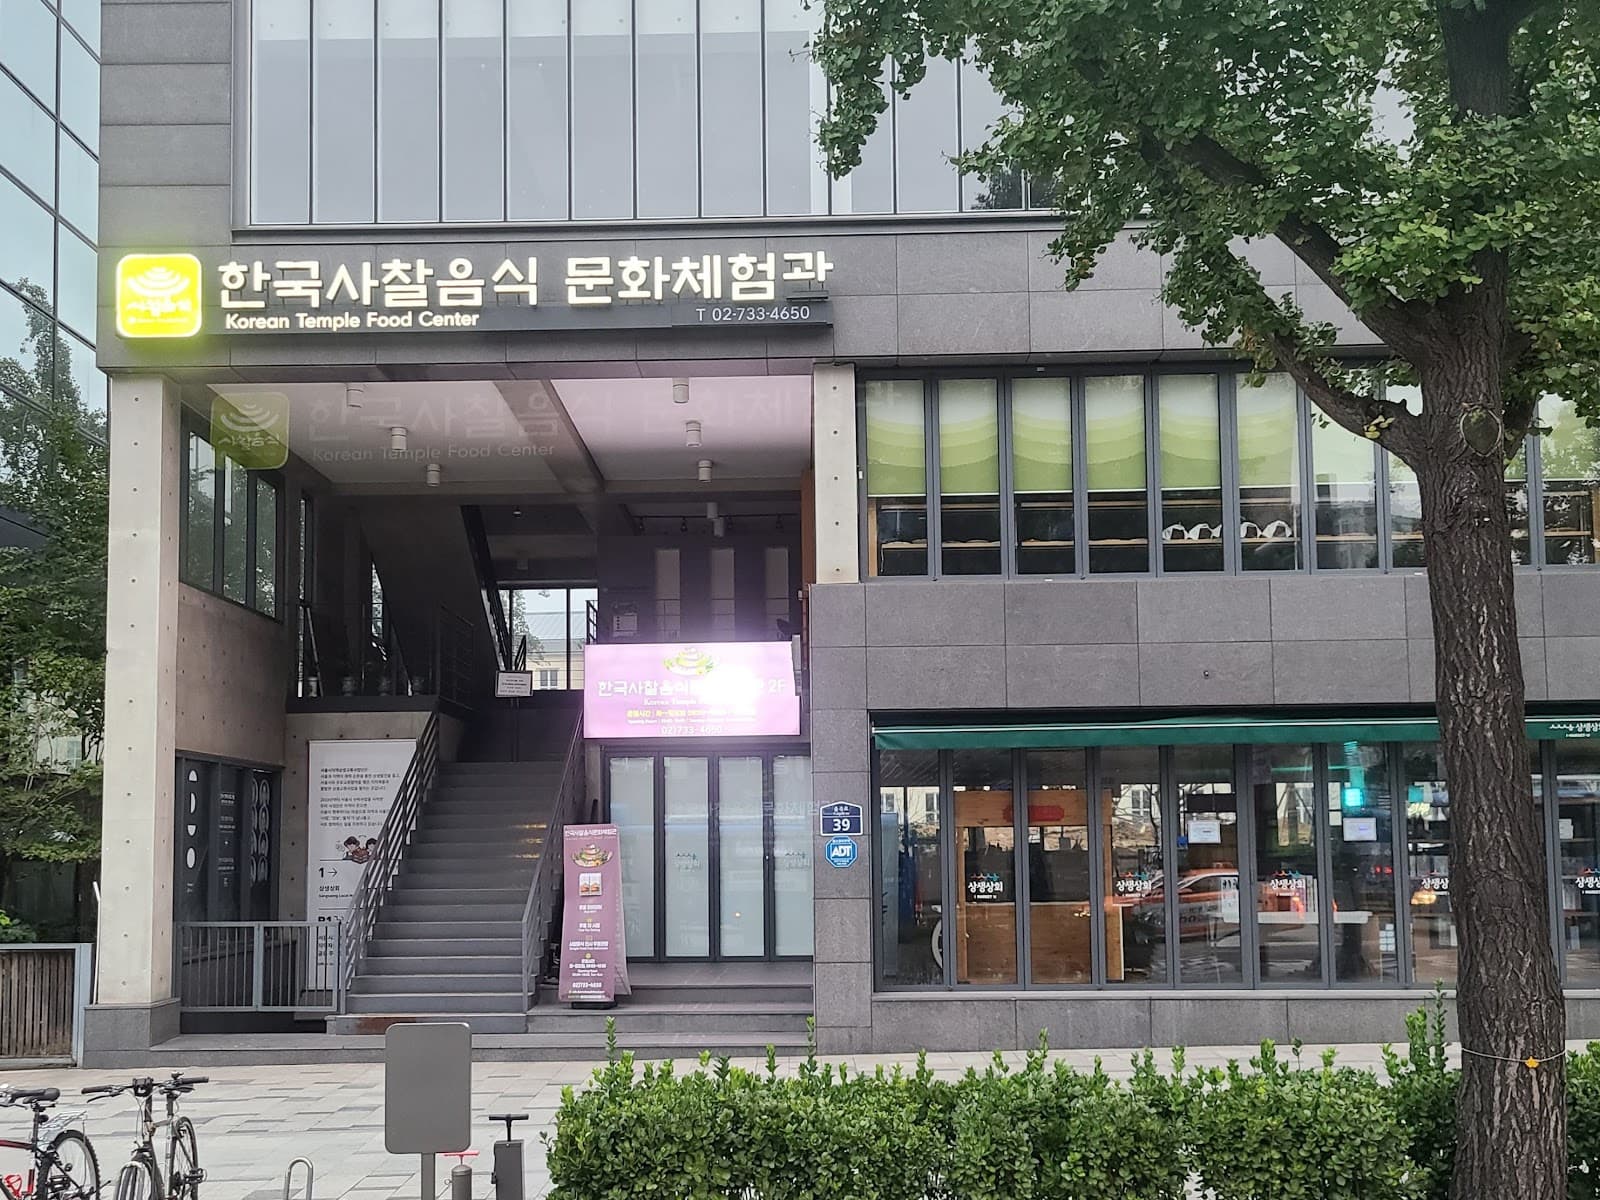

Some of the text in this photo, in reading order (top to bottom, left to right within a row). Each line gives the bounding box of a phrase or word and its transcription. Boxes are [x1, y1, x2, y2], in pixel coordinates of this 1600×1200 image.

[218, 251, 834, 309] 한국사찰음식 문화체험관
[696, 305, 810, 322] T 02-733-4650
[225, 311, 480, 332] Korean Temple Food Center
[1574, 722, 1600, 732] 상생상
[832, 818, 851, 832] 39
[831, 845, 852, 857] ADT
[318, 867, 325, 878] 1
[968, 880, 1004, 893] 상생상회
[1116, 879, 1152, 892] 상생상회
[1270, 878, 1306, 890] 상생상회
[1421, 877, 1449, 890] 상생상
